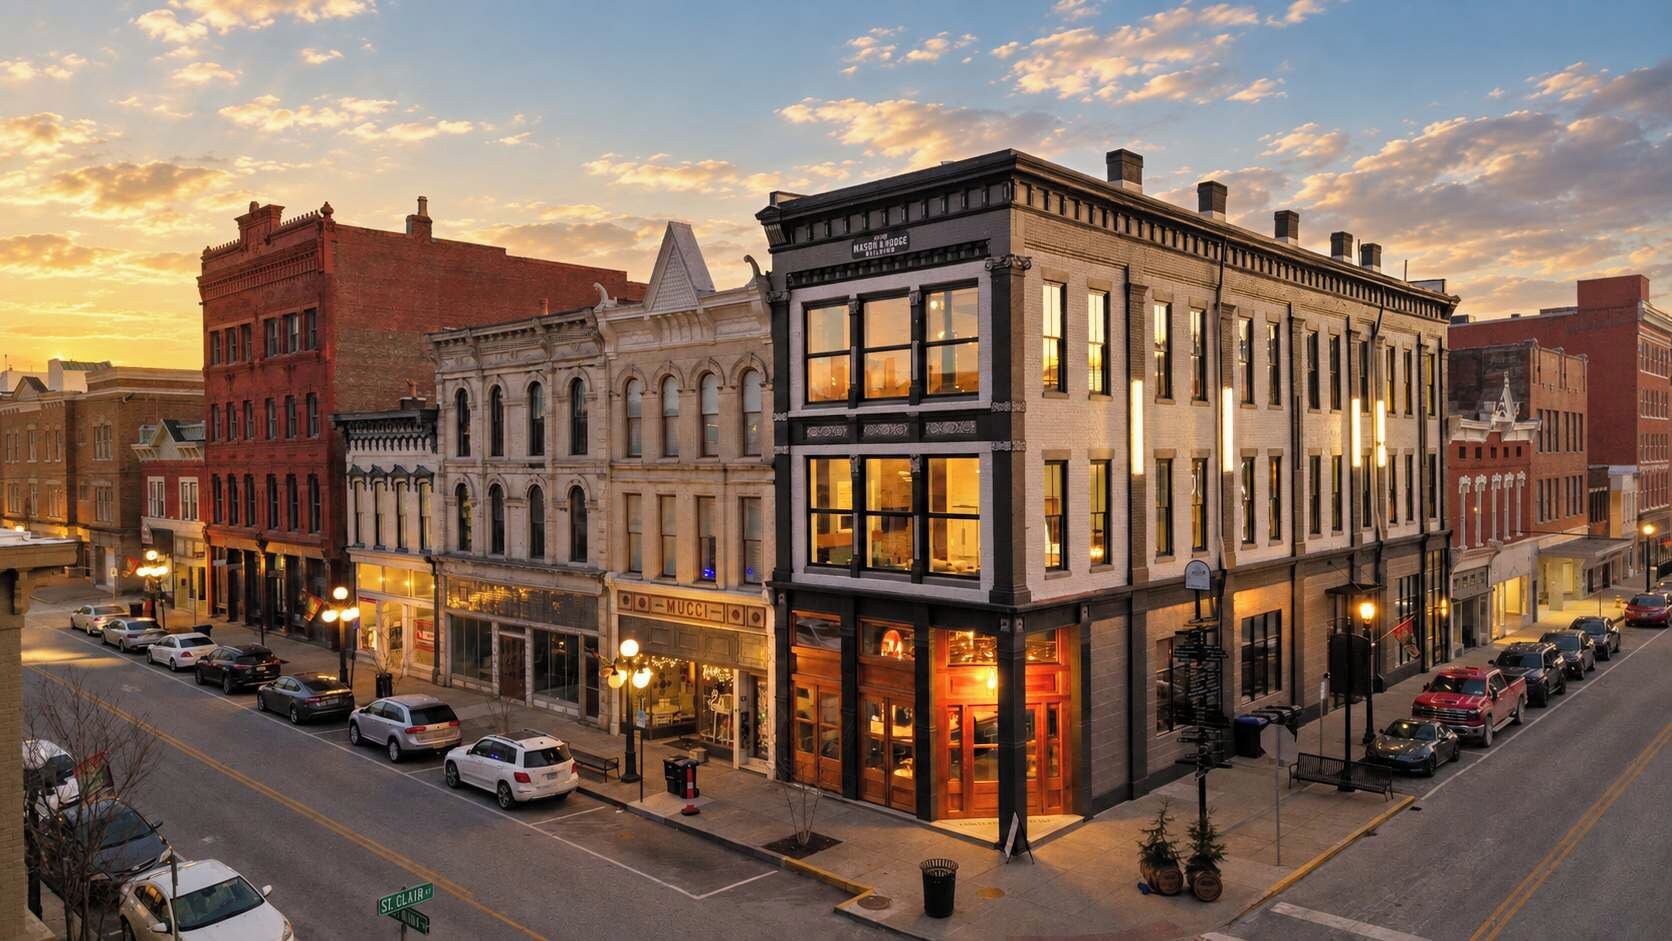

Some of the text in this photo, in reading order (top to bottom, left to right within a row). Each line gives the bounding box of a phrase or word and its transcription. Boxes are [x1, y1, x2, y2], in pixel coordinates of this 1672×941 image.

[853, 241, 878, 253] MASON
[666, 600, 708, 618] MUCCI
[381, 898, 394, 913] ST.
[396, 887, 424, 908] CLAIR
